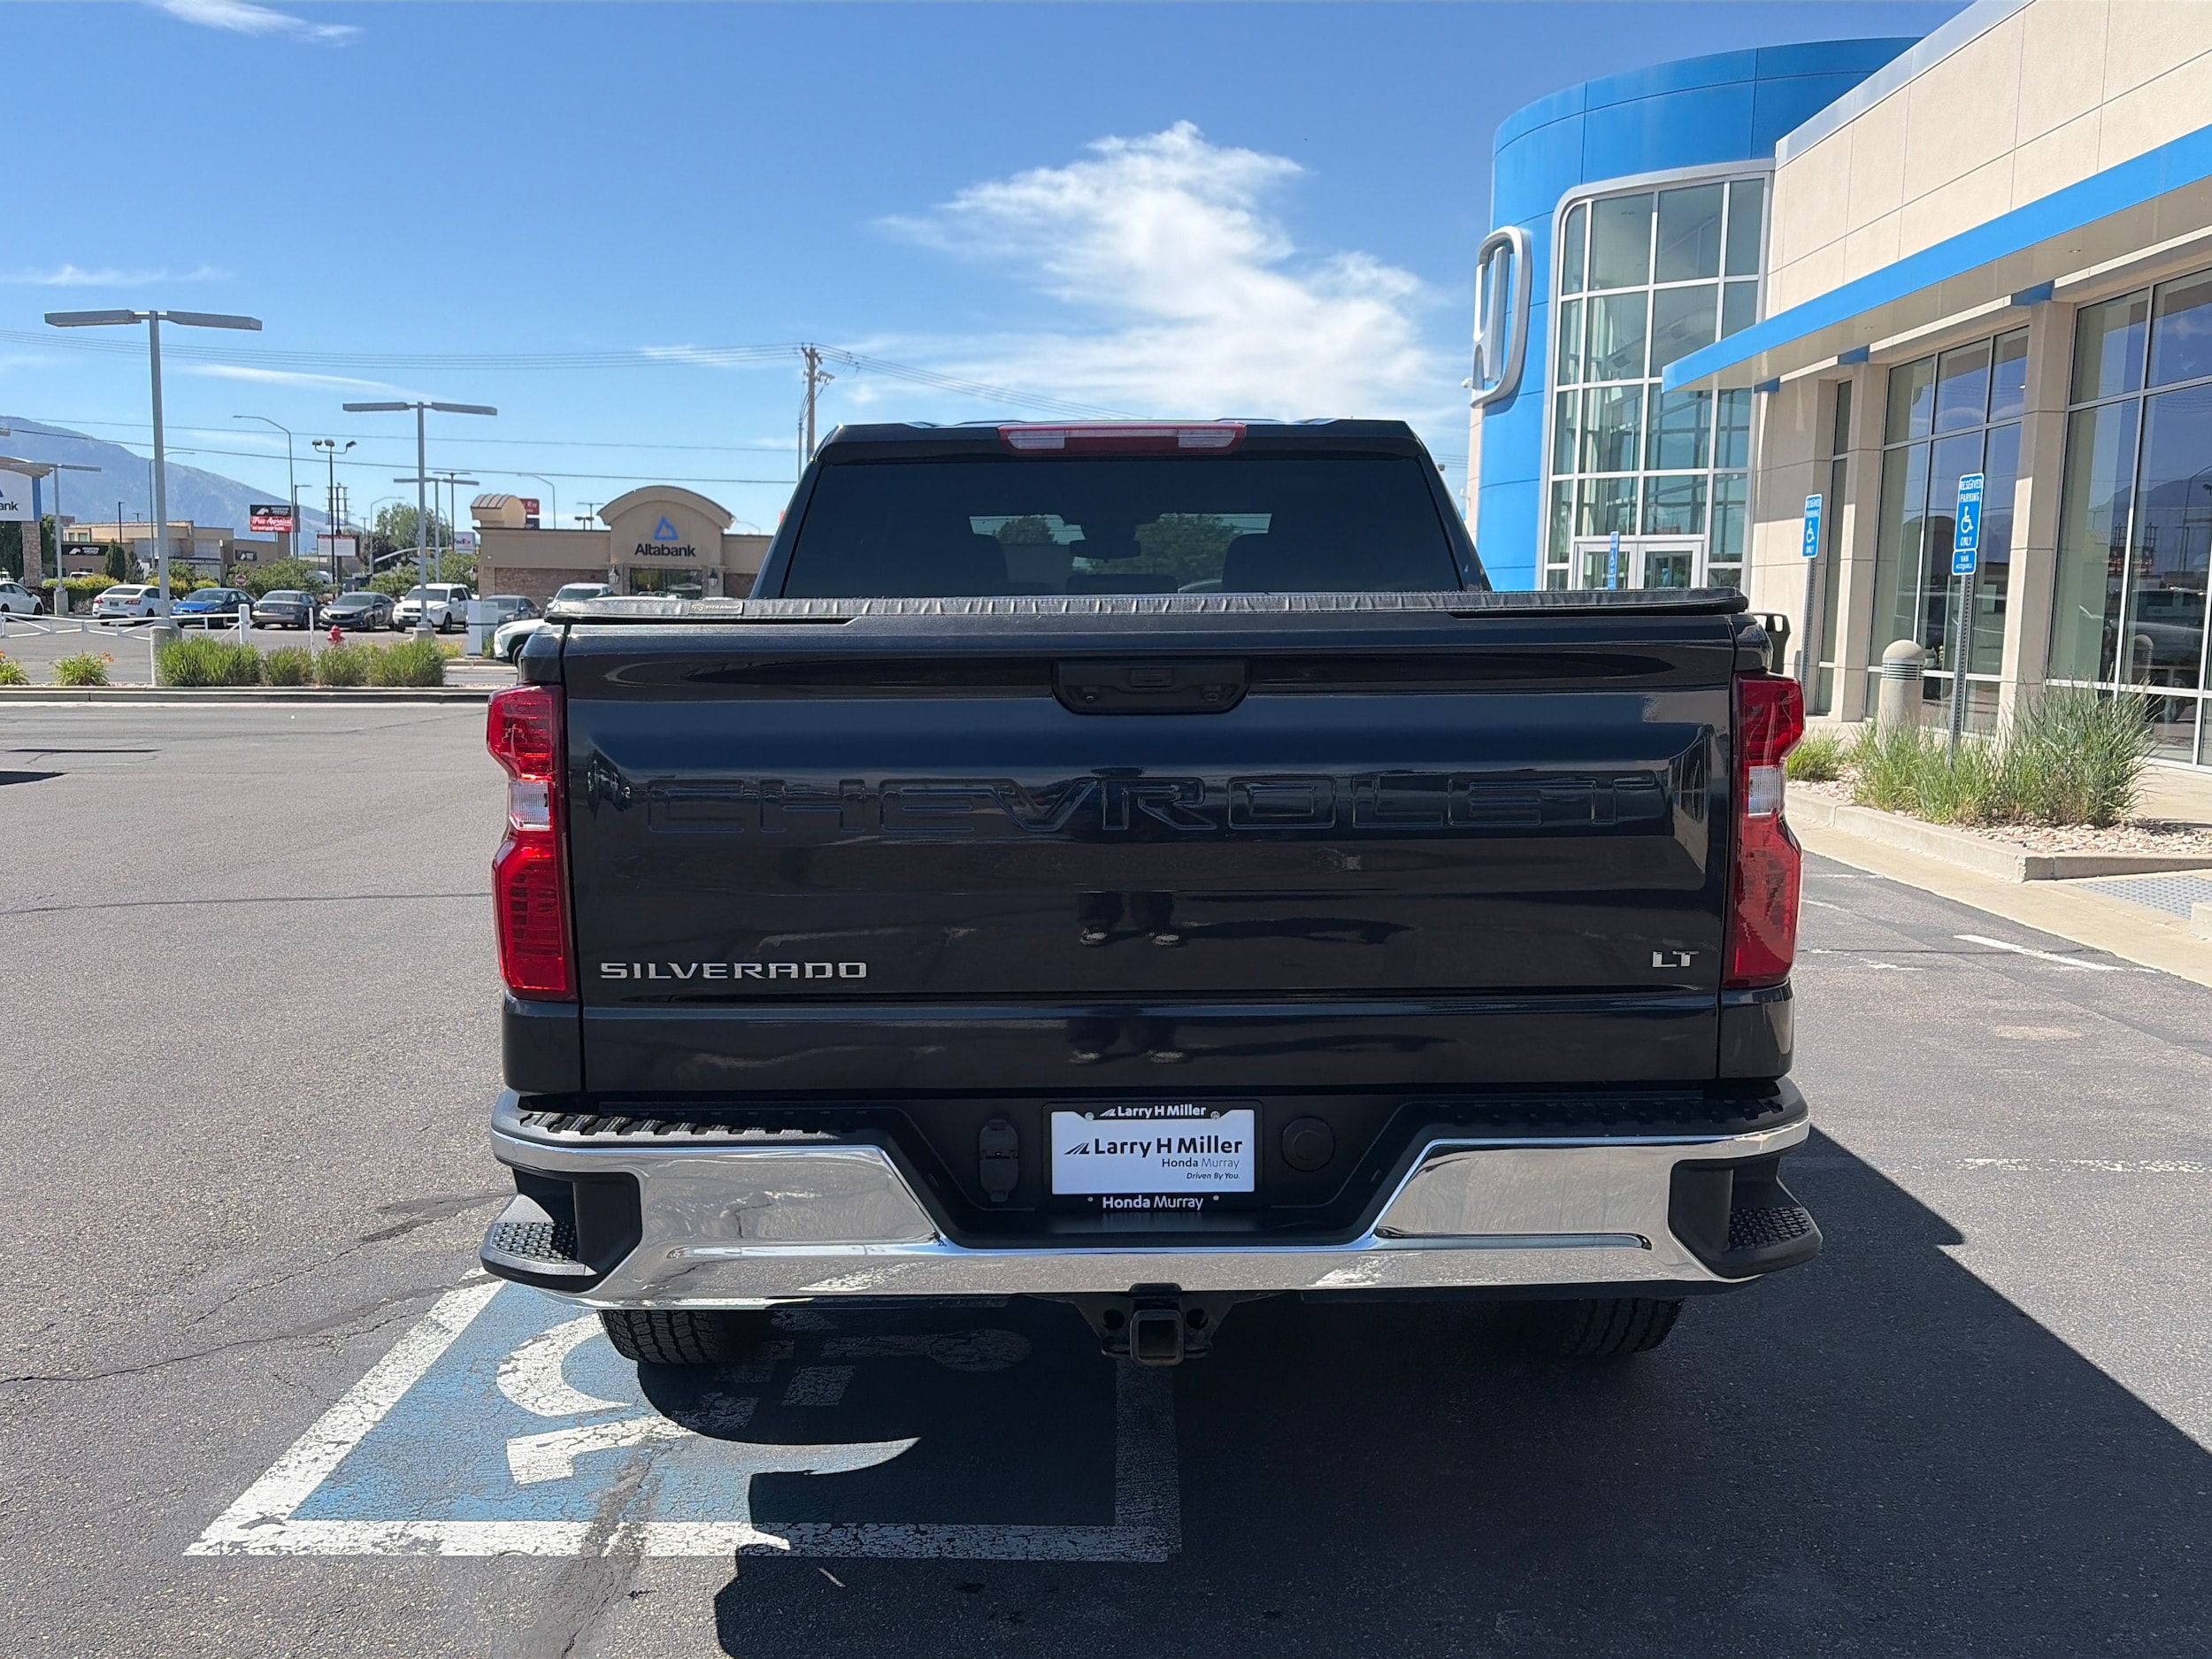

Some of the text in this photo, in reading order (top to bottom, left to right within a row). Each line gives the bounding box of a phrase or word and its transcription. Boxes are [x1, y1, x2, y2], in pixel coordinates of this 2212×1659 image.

[1960, 479, 1982, 490] RESERVED
[1960, 492, 1980, 503] PARKING
[1960, 536, 1972, 547] ONLY
[634, 542, 696, 557] Altabank
[648, 770, 1658, 834] CHEVROLET
[1652, 950, 1700, 968] LT
[600, 962, 868, 979] SILVERADO
[1118, 1103, 1207, 1118] Larry H Miller
[1094, 1135, 1243, 1158] Larry H Miller
[1162, 1157, 1240, 1169] Honda Murray
[1187, 1171, 1211, 1180] Driven
[1213, 1171, 1223, 1181] By
[1102, 1195, 1204, 1210] Honda Murray
